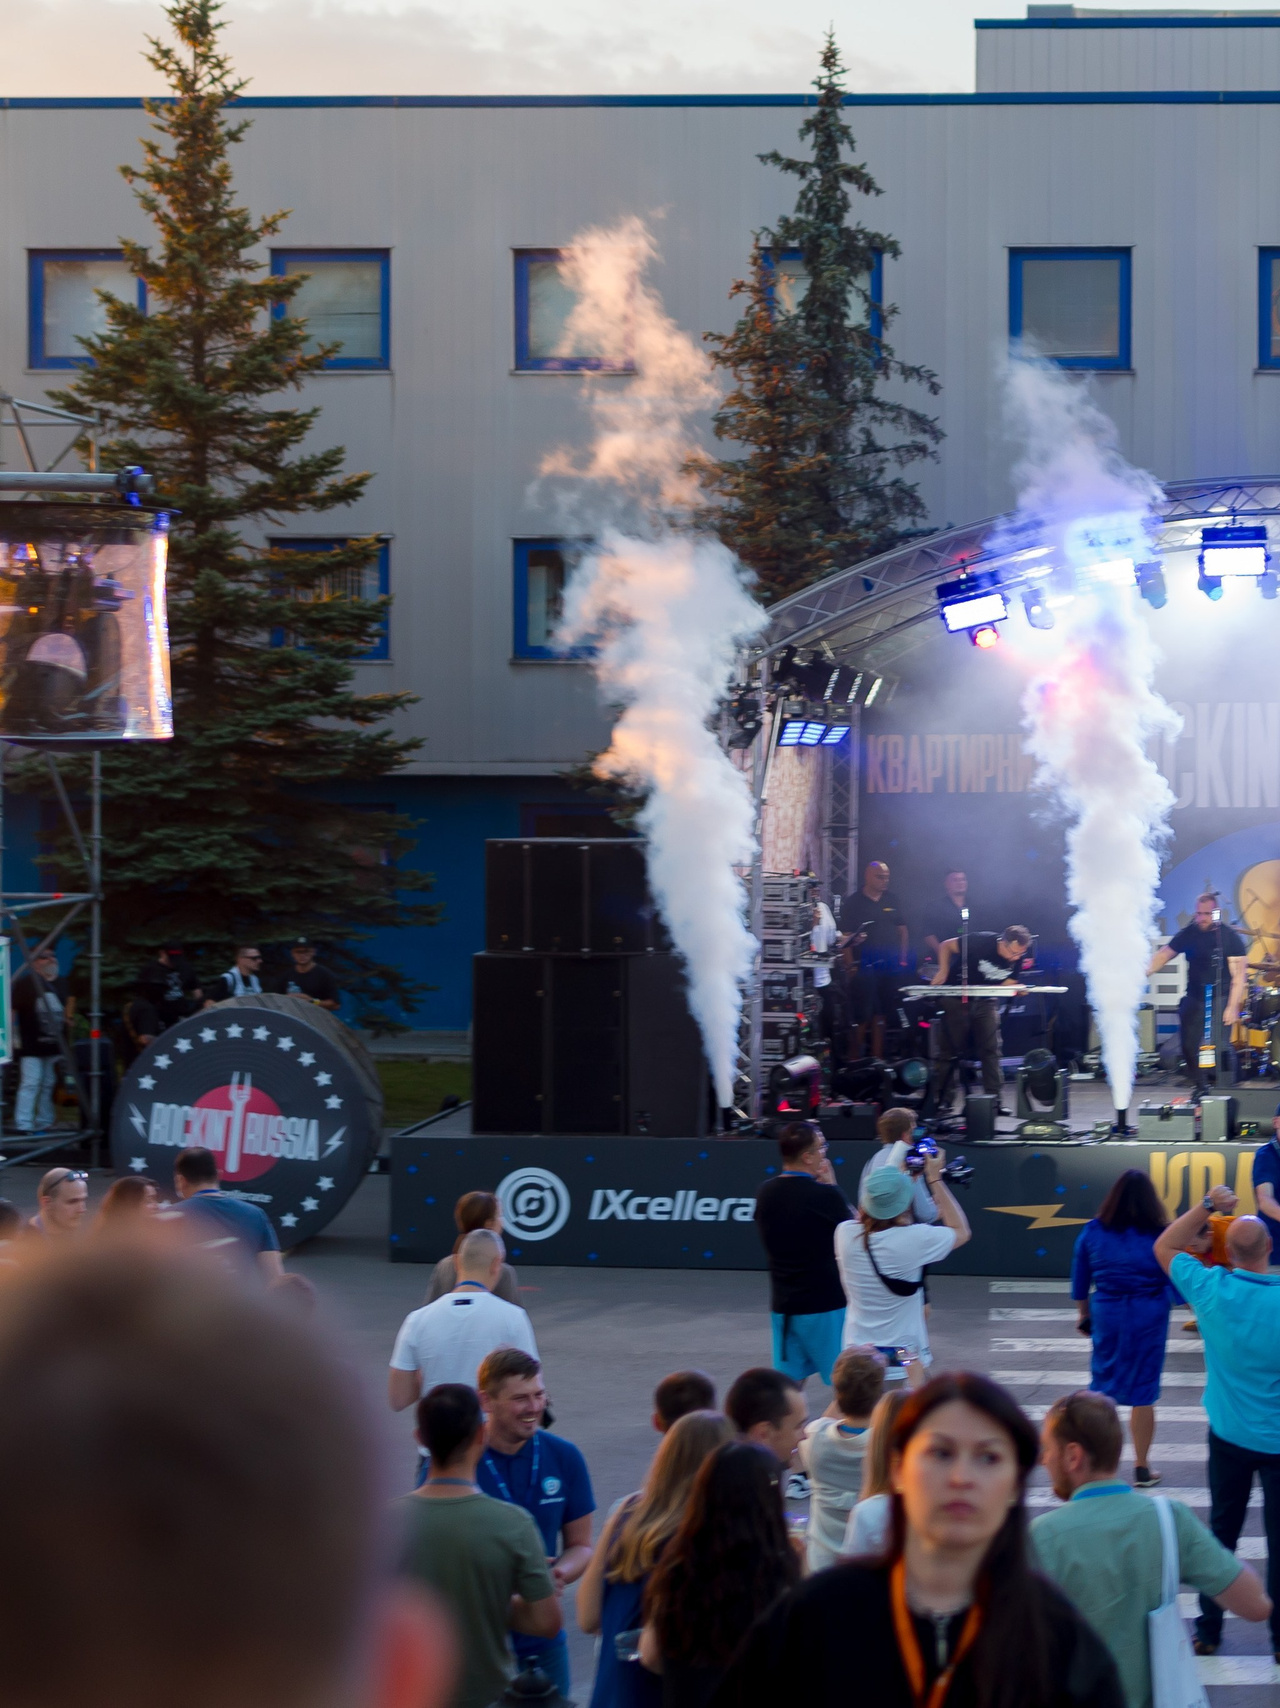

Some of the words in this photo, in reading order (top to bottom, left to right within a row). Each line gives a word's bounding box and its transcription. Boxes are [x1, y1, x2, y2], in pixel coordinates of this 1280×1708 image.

[866, 734, 1044, 793] КВАРТИРНИ
[243, 1112, 320, 1161] RUSSIA
[588, 1189, 757, 1222] IXcellera
